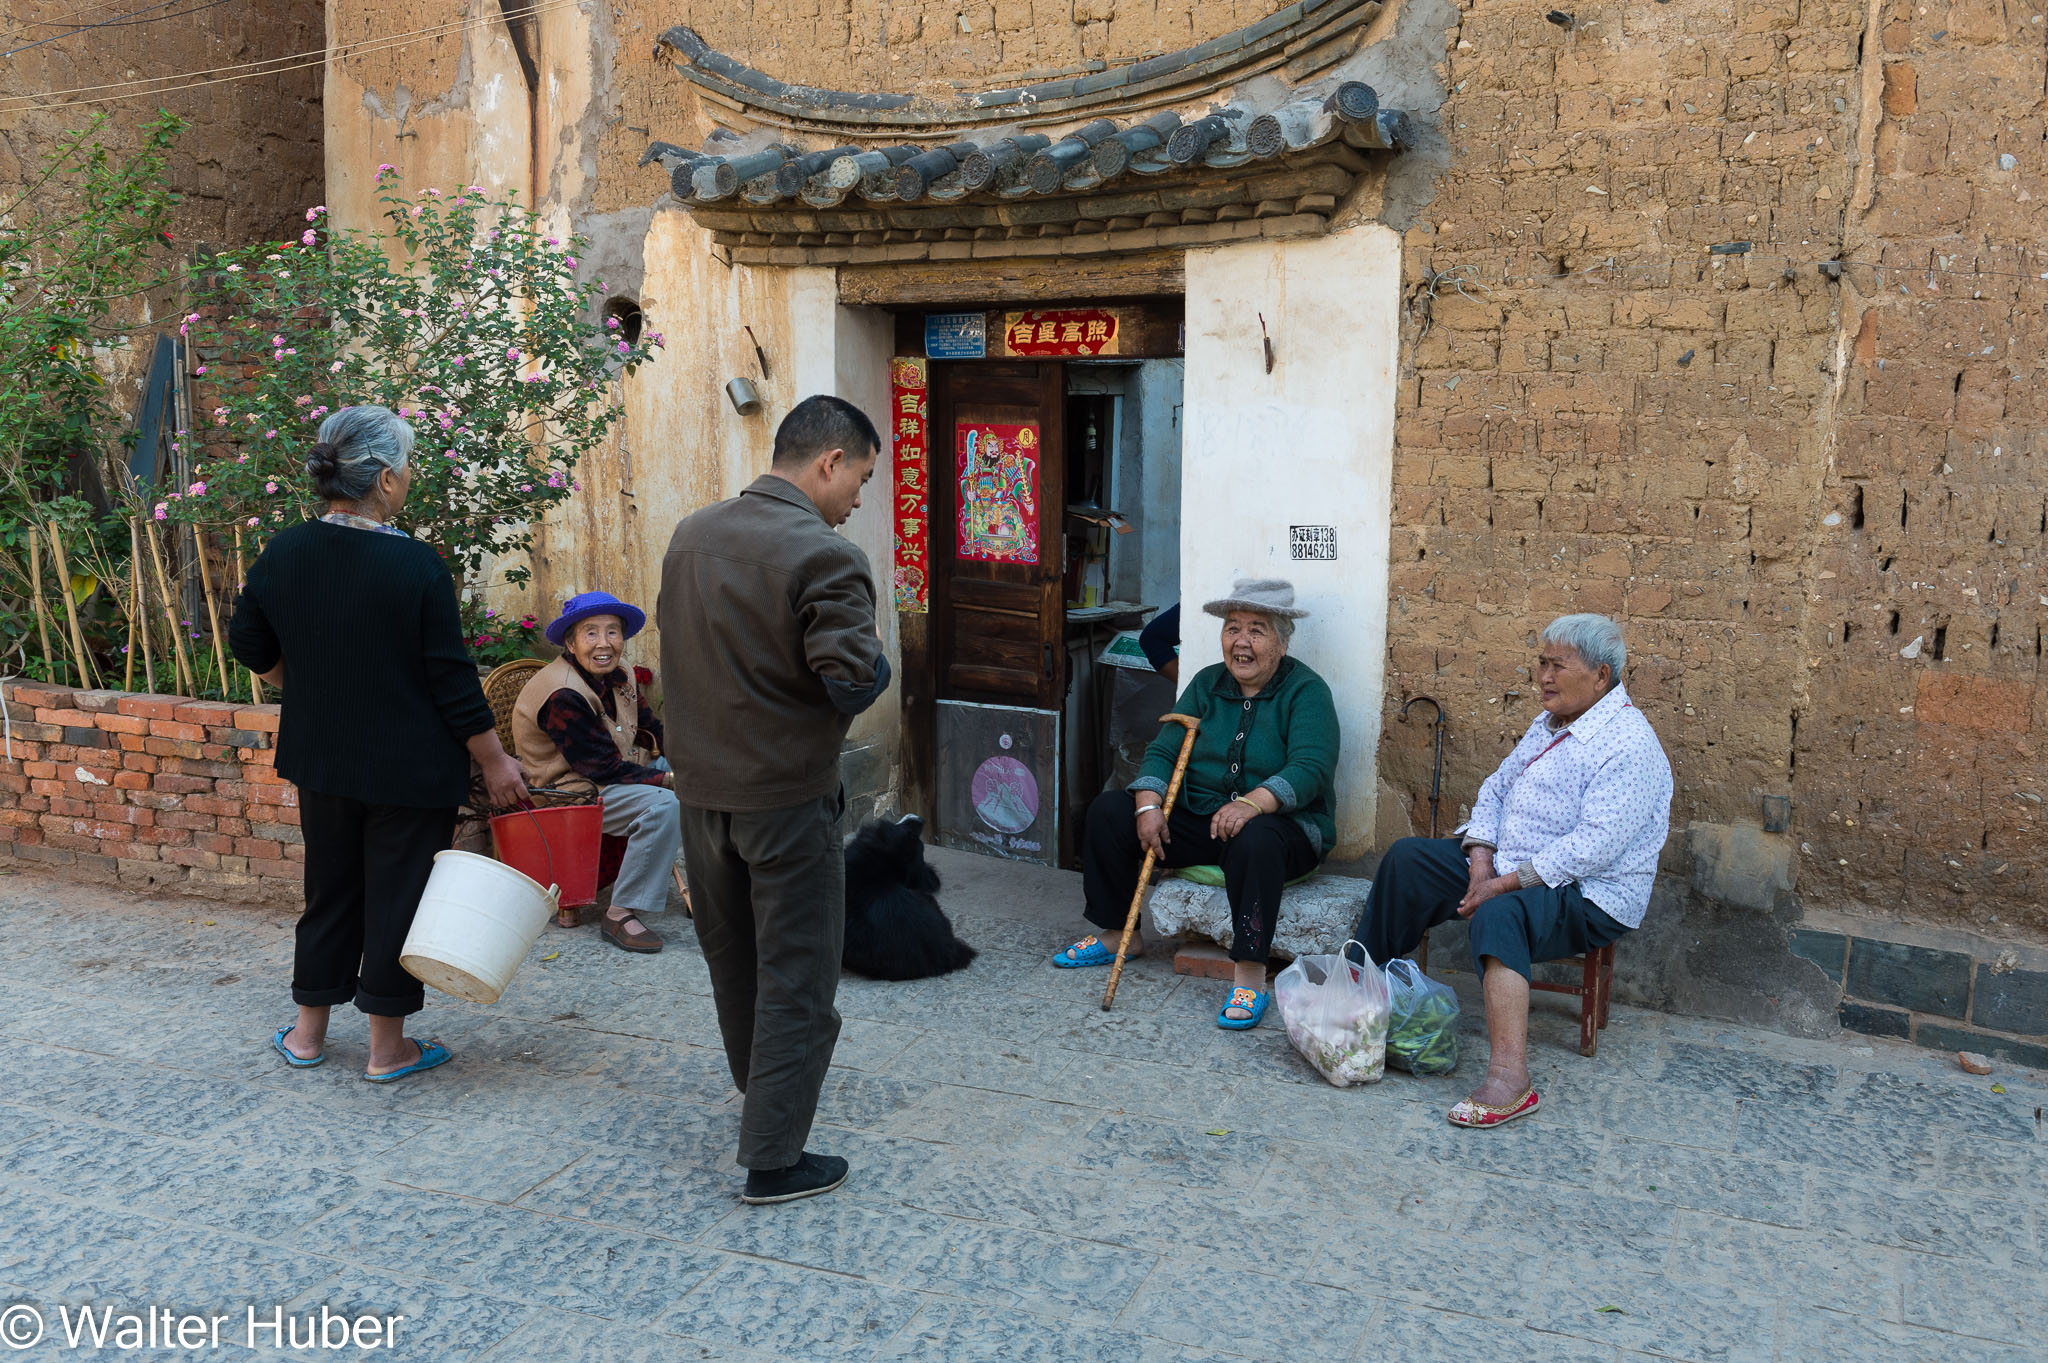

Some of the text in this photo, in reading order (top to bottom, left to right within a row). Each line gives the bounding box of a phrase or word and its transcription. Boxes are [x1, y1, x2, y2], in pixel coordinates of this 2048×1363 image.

[1013, 319, 1109, 343] 吉星高照
[1023, 430, 1030, 443] 月
[899, 391, 923, 562] 吉祥如意万事兴
[1292, 543, 1335, 558] 88146219
